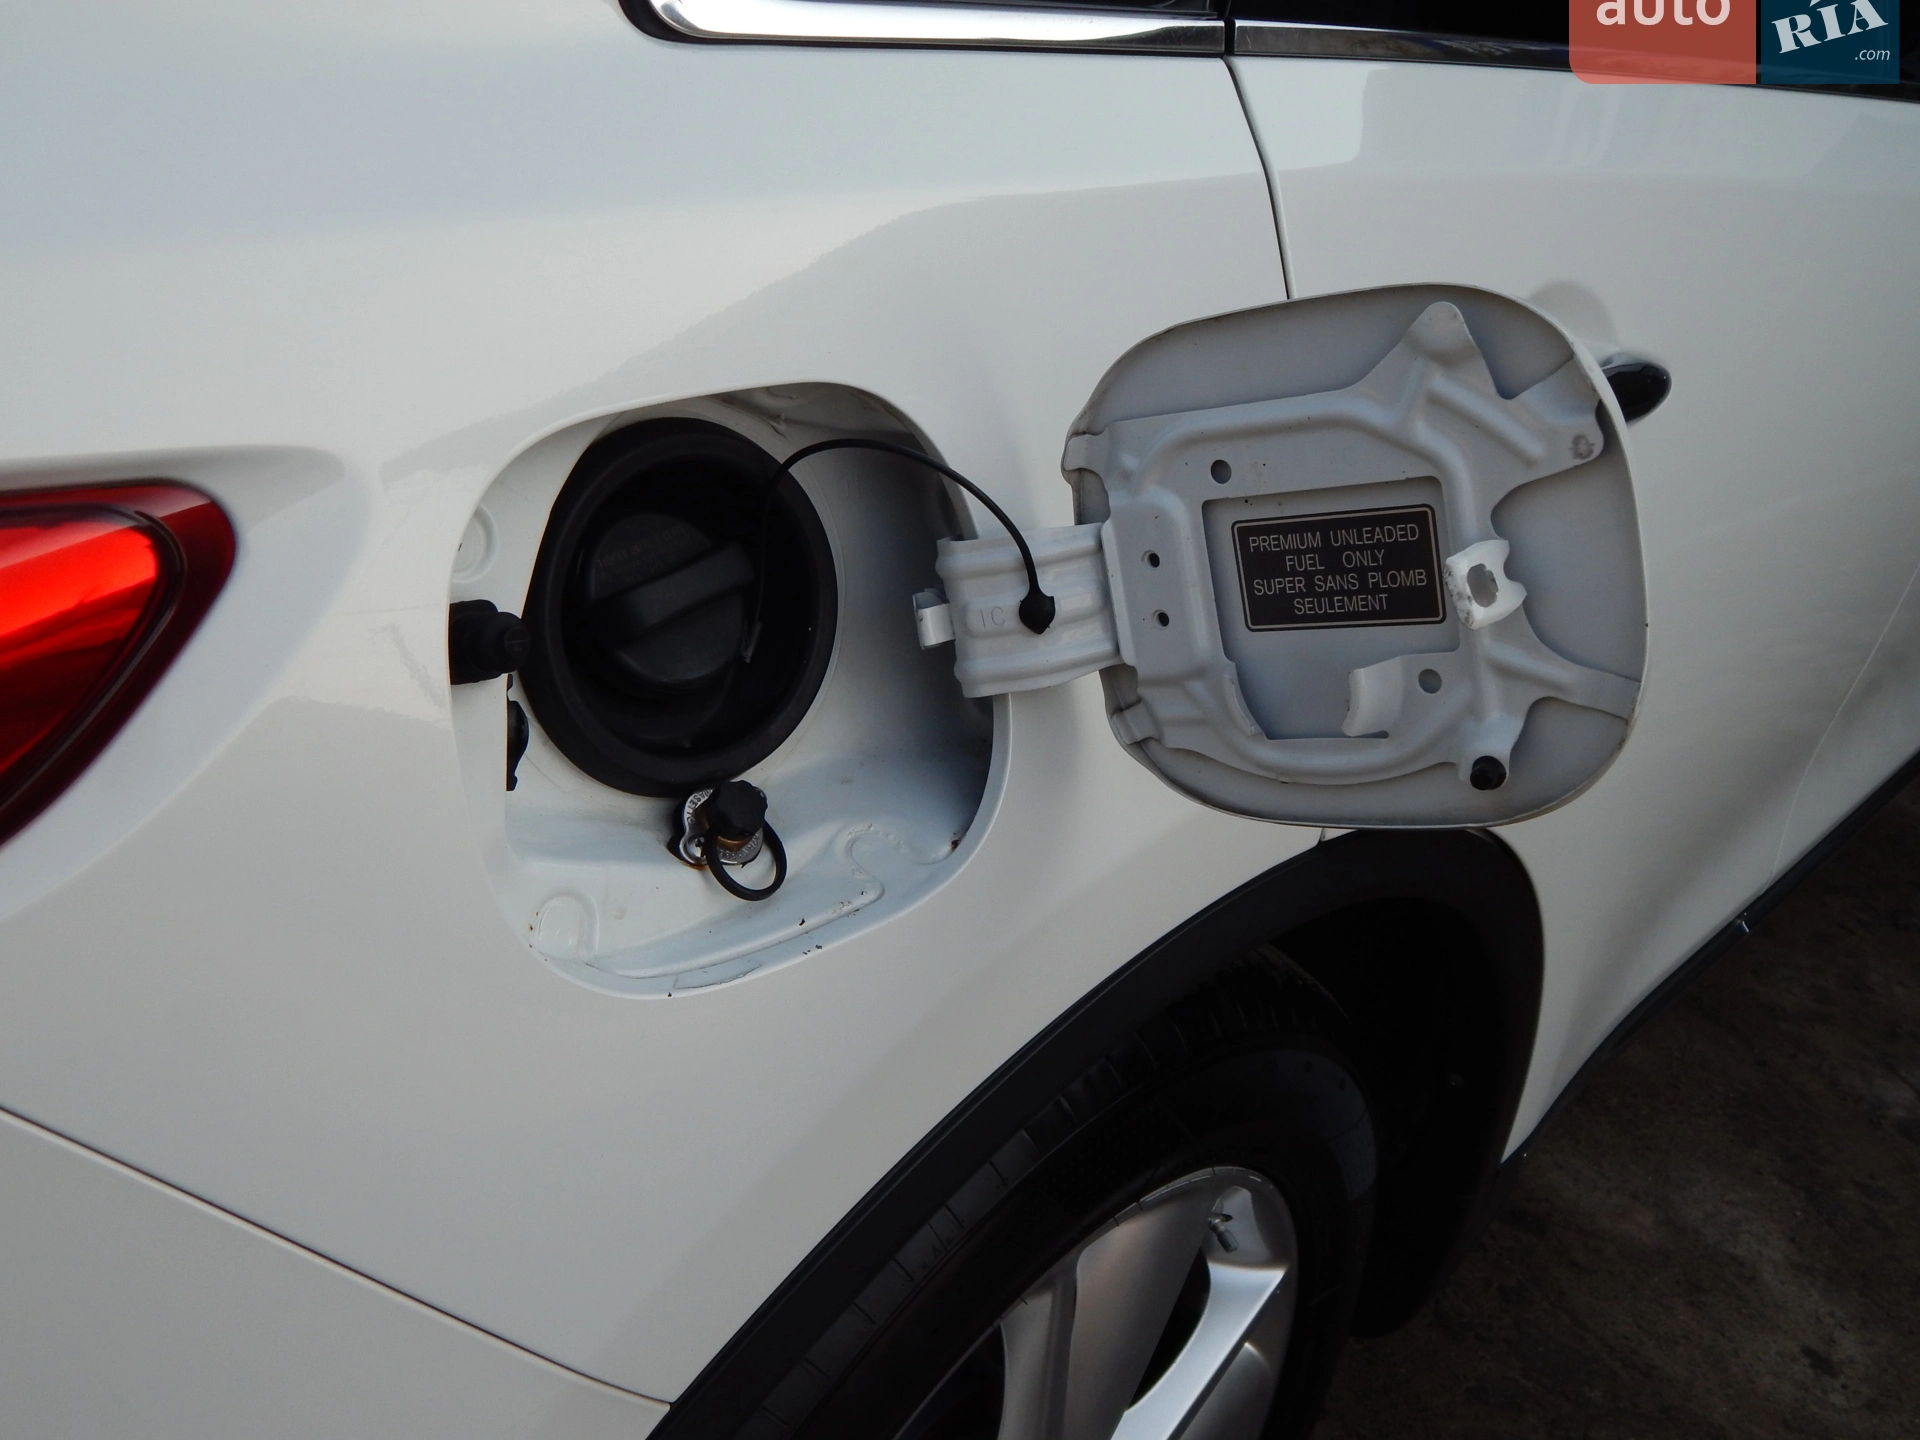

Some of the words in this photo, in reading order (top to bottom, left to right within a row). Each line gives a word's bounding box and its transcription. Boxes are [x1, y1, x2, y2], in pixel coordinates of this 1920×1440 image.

[1249, 532, 1322, 552] PREMIUM
[1330, 524, 1419, 547] UNLEADED
[1286, 554, 1325, 572] FUEL
[1343, 549, 1385, 568] ONLY
[1254, 576, 1306, 595] SUPER
[1315, 573, 1359, 592] SANS
[1368, 569, 1427, 589] PLOMB
[1294, 594, 1388, 615] SEULEMENT
